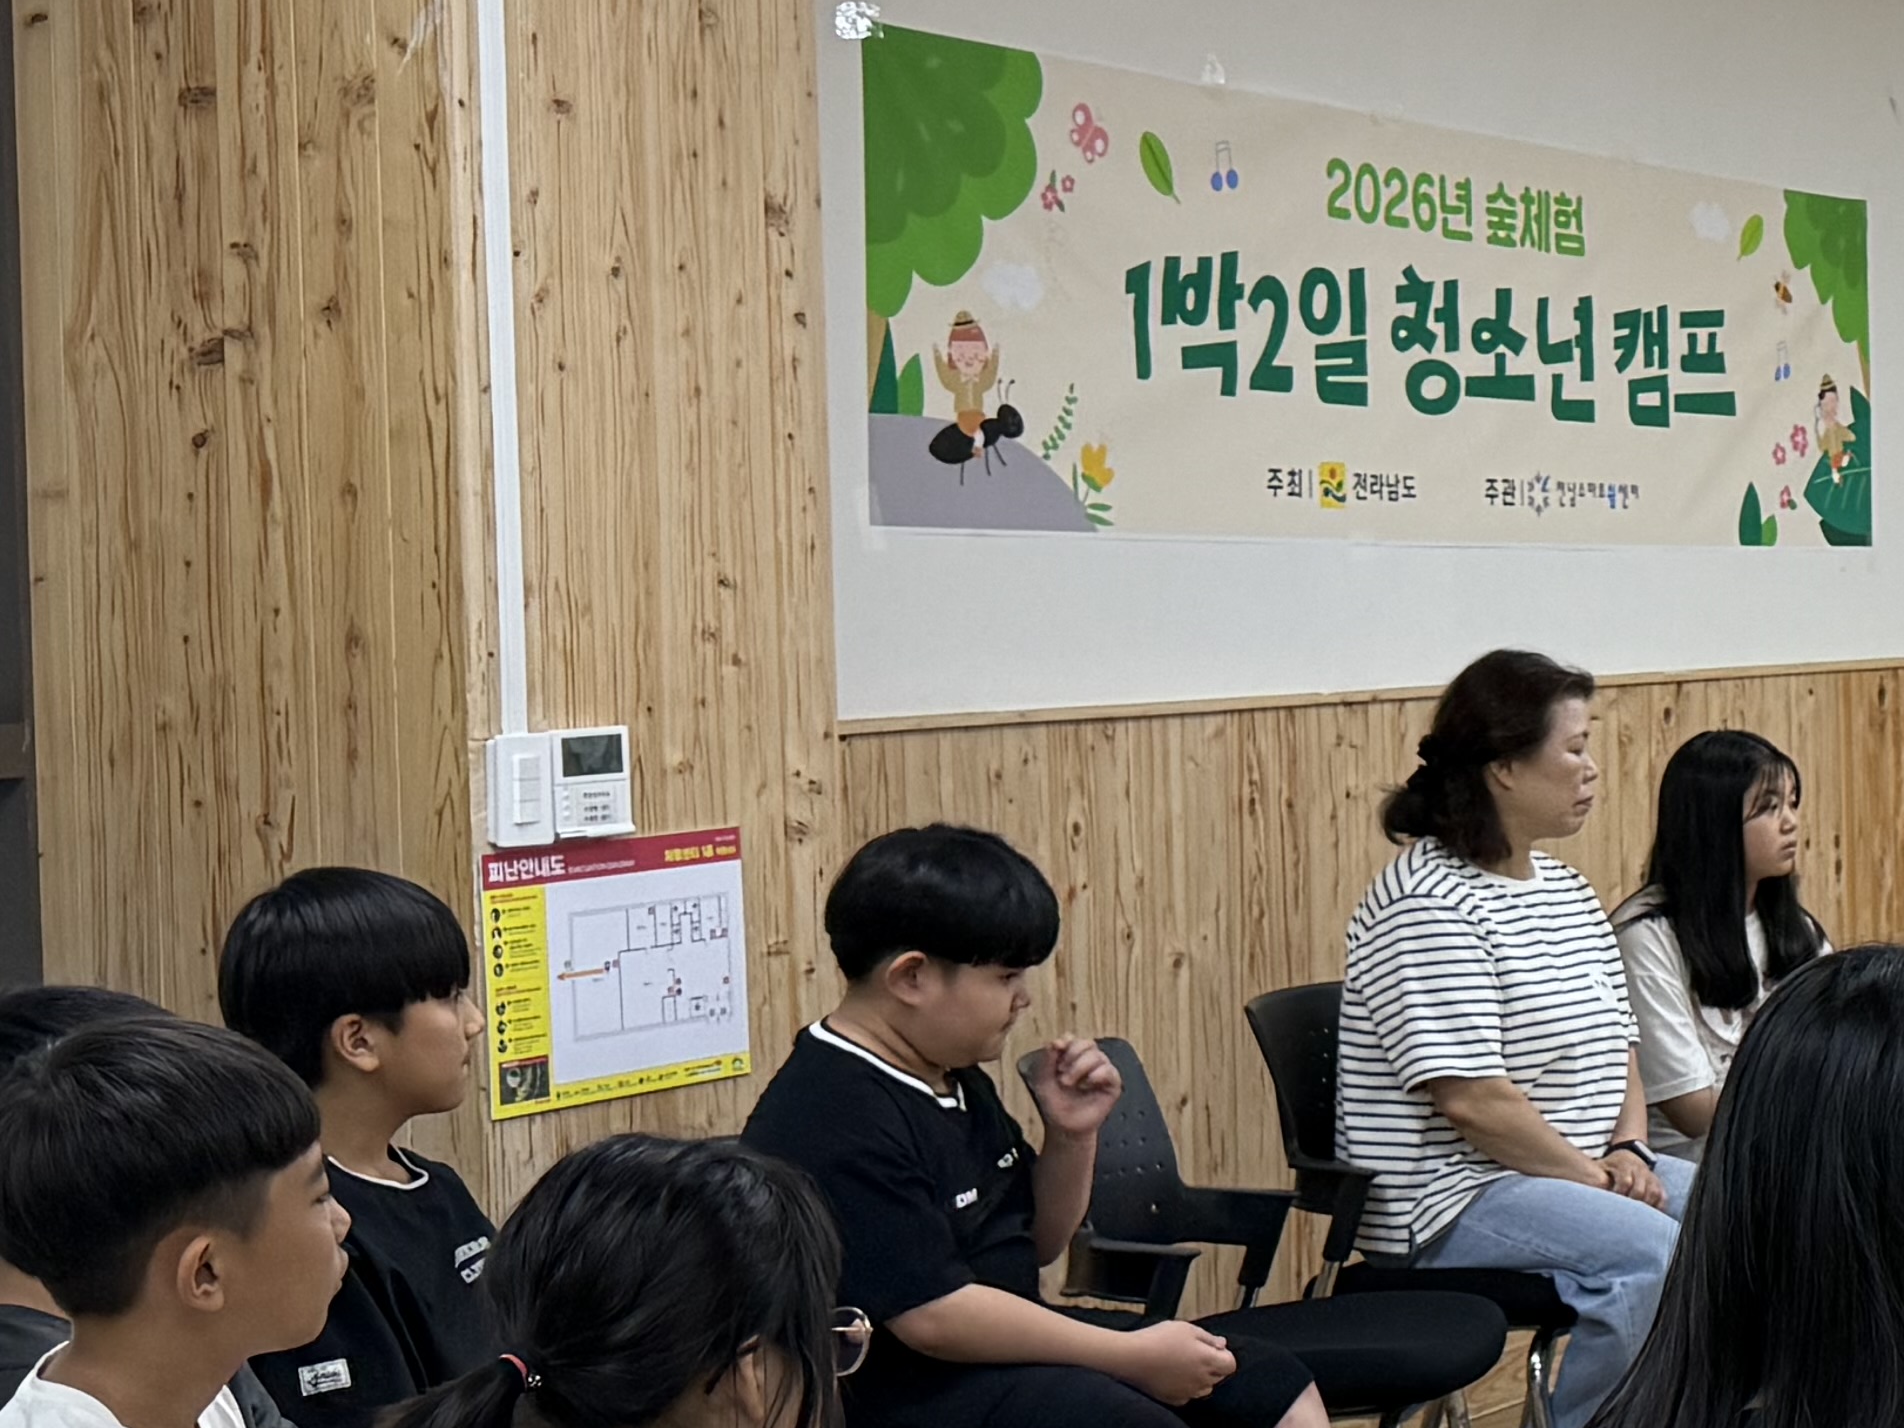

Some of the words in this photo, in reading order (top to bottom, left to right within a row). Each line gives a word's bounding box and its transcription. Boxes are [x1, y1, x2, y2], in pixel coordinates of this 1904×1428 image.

[1325, 157, 1474, 242] 2026년
[1485, 181, 1586, 257] 숲체험
[1124, 250, 1369, 407] 1박2일
[1391, 264, 1597, 424] 청소년
[1613, 305, 1737, 429] 캠프
[1265, 467, 1303, 499] 주최
[1352, 471, 1418, 503] 전라남도
[1483, 477, 1517, 508] 주관
[488, 855, 566, 883] 피난안내도
